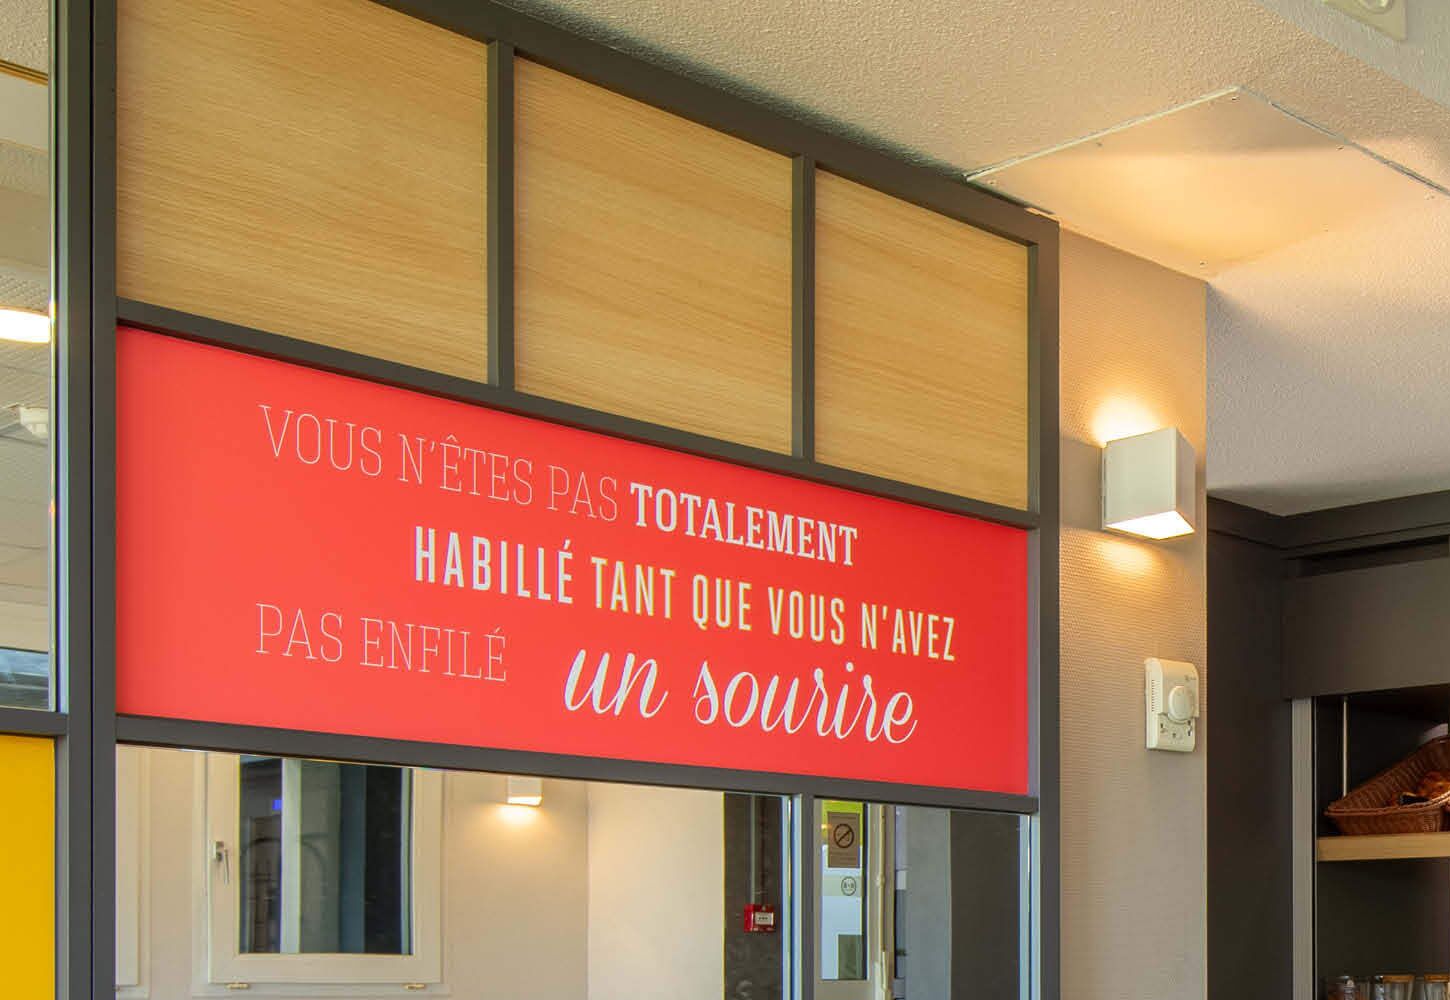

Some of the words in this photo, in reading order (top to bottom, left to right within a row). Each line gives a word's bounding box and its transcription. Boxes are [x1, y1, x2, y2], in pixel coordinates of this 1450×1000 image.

[258, 405, 383, 476] VOUS
[398, 433, 533, 506] N'ÊTES
[547, 465, 618, 522] PAS
[630, 482, 859, 568] TOTALEMENT
[415, 526, 574, 604] HABILLÉ
[591, 556, 676, 620] TANT
[692, 574, 752, 632] QUE
[768, 587, 846, 646] VOUS
[861, 602, 956, 662] N'AVEZ
[255, 602, 344, 663] PAS
[360, 618, 507, 683] ENFILÉ
[564, 649, 668, 719] un
[692, 660, 918, 744] sourire
